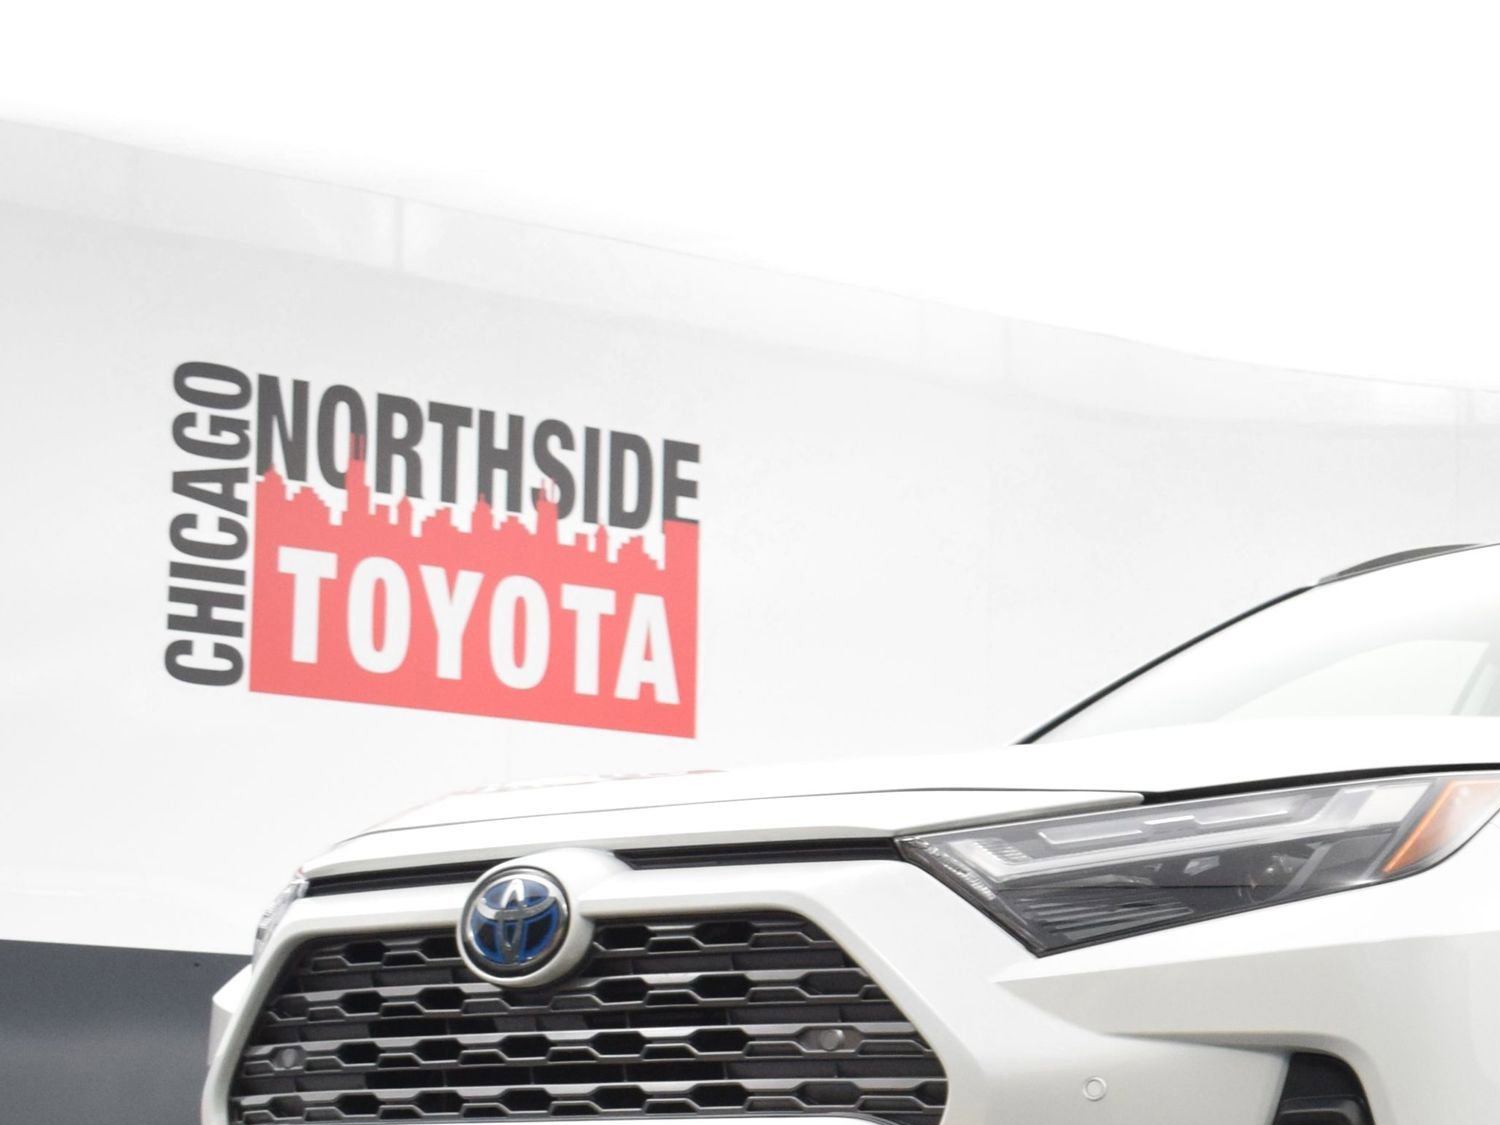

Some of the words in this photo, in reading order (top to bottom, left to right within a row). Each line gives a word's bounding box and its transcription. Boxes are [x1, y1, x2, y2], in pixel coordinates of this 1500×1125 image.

[165, 361, 252, 687] CHICAGO
[256, 373, 700, 533] NORTHSIDE
[277, 545, 681, 705] TOYOTA
